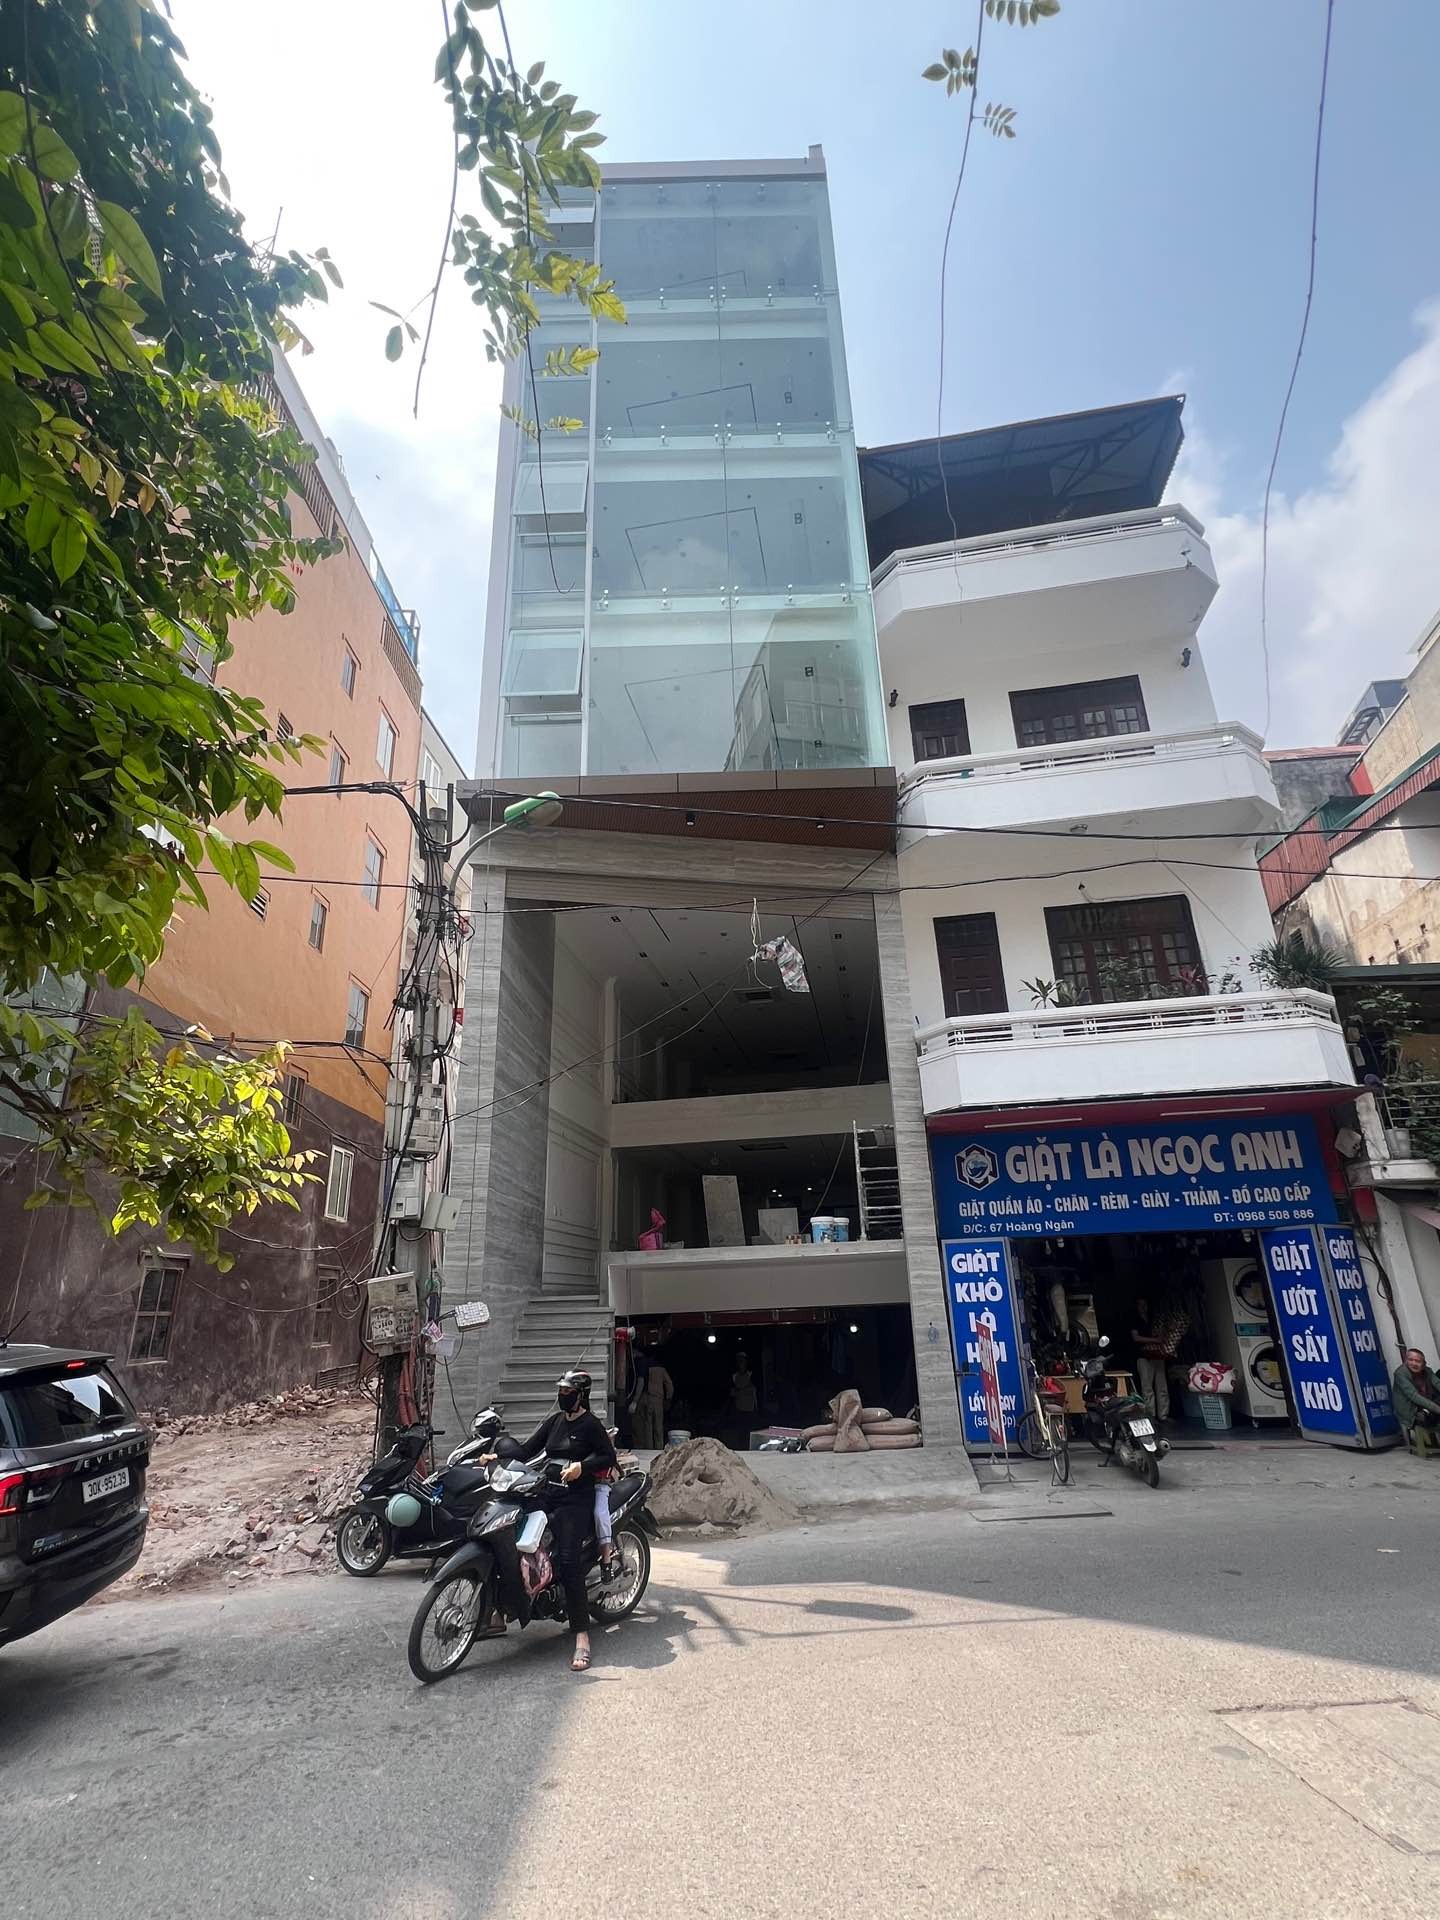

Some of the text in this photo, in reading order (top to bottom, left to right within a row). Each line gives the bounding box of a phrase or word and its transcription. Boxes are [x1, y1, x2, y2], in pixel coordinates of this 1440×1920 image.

[1005, 1130, 1304, 1191] GIẶT LÀ NGỌC ANH
[959, 1199, 985, 1220] GIẶT
[1100, 1191, 1130, 1210] RÈM
[1140, 1189, 1171, 1208] GIÀY
[1254, 1187, 1281, 1203] CAO
[1284, 1180, 1311, 1202] CẤP
[963, 1220, 1075, 1234] Đ/C: 67 Hoàng Ngân
[1214, 1212, 1235, 1222] ĐT:
[1237, 1211, 1265, 1221] 0968
[1293, 1208, 1315, 1219] 886
[951, 1248, 1000, 1277] GIẶT
[1270, 1240, 1312, 1276] GIẶT
[1329, 1235, 1356, 1264] GIẶT
[954, 1277, 1003, 1303] KHÔ
[1335, 1265, 1363, 1290] KHÔ
[1282, 1284, 1319, 1316] ƯỚT
[1348, 1295, 1366, 1321] LÀ
[1292, 1325, 1329, 1363] SẤY
[1352, 1329, 1376, 1353] HƠI
[1300, 1377, 1343, 1412] KHÔ
